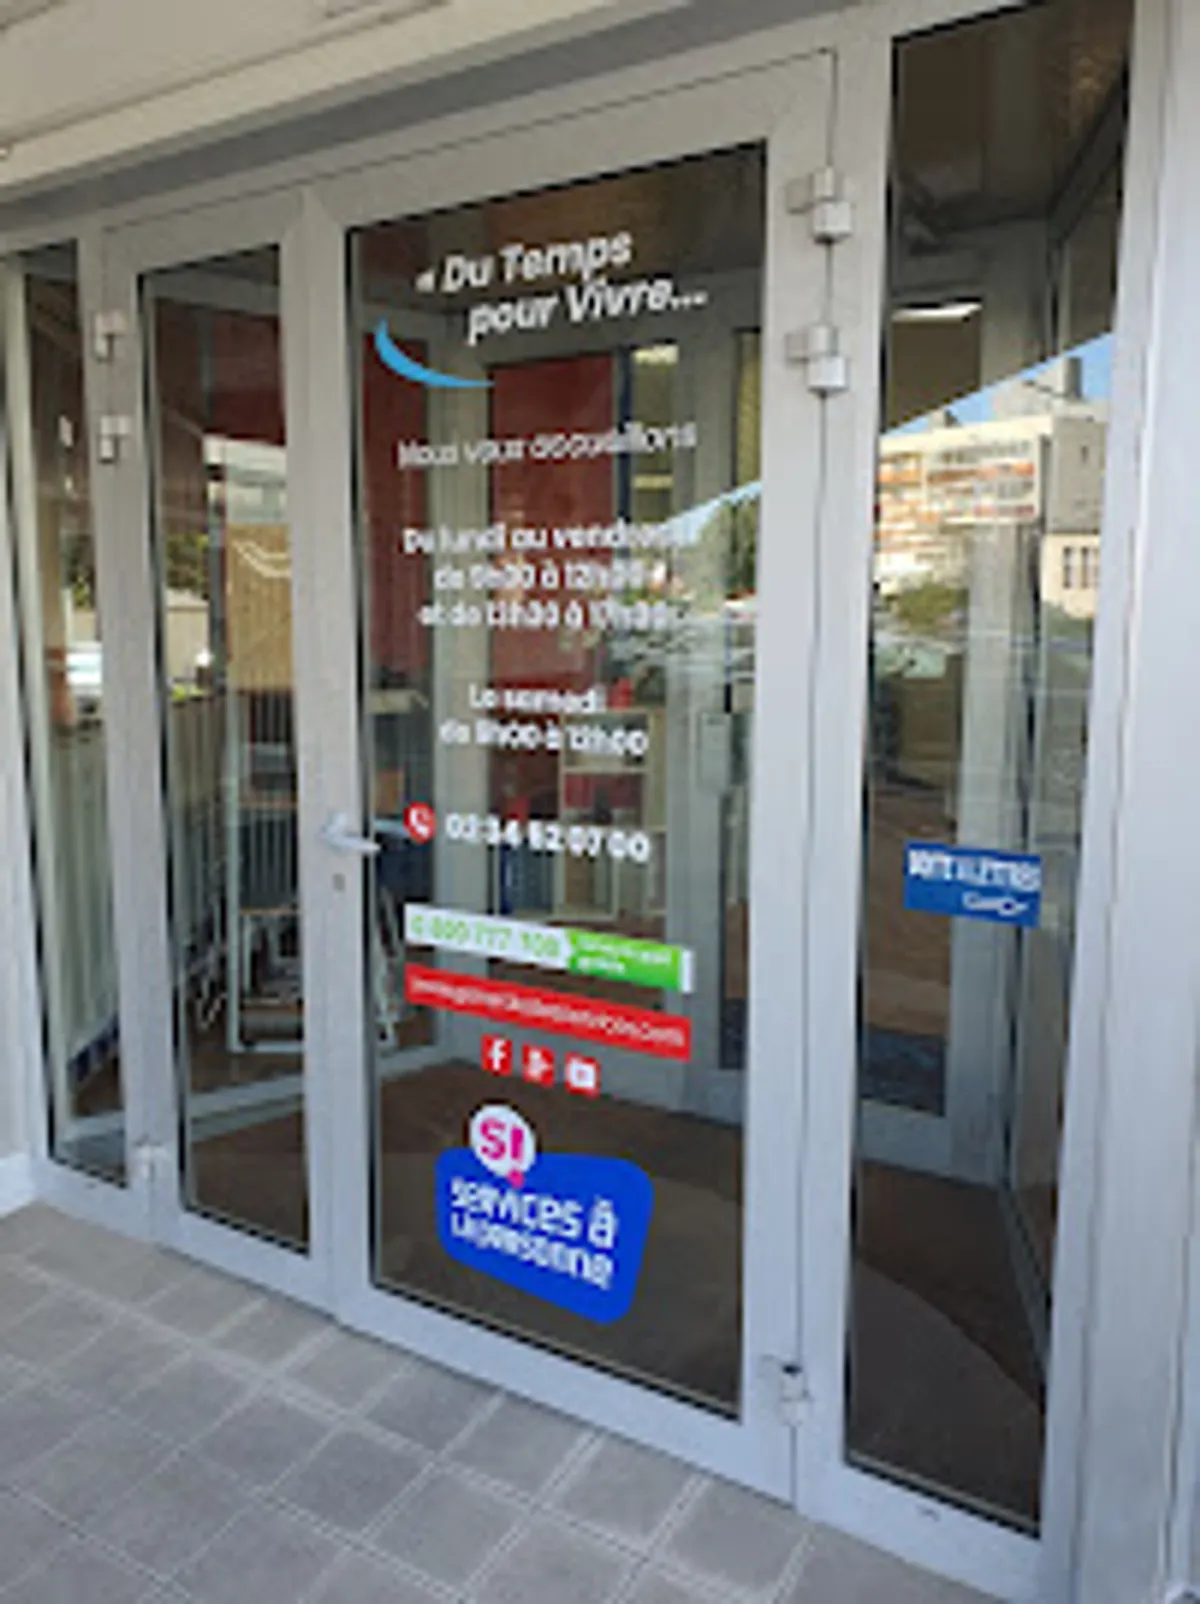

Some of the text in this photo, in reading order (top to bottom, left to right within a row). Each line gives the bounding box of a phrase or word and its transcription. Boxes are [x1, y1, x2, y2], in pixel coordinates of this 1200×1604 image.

[441, 253, 492, 293] Du
[499, 230, 633, 283] Temps
[465, 290, 559, 347] pour
[398, 439, 459, 471] Nous
[463, 438, 525, 464] vous
[510, 526, 547, 549] au
[540, 556, 560, 590] à
[468, 683, 497, 709] Le
